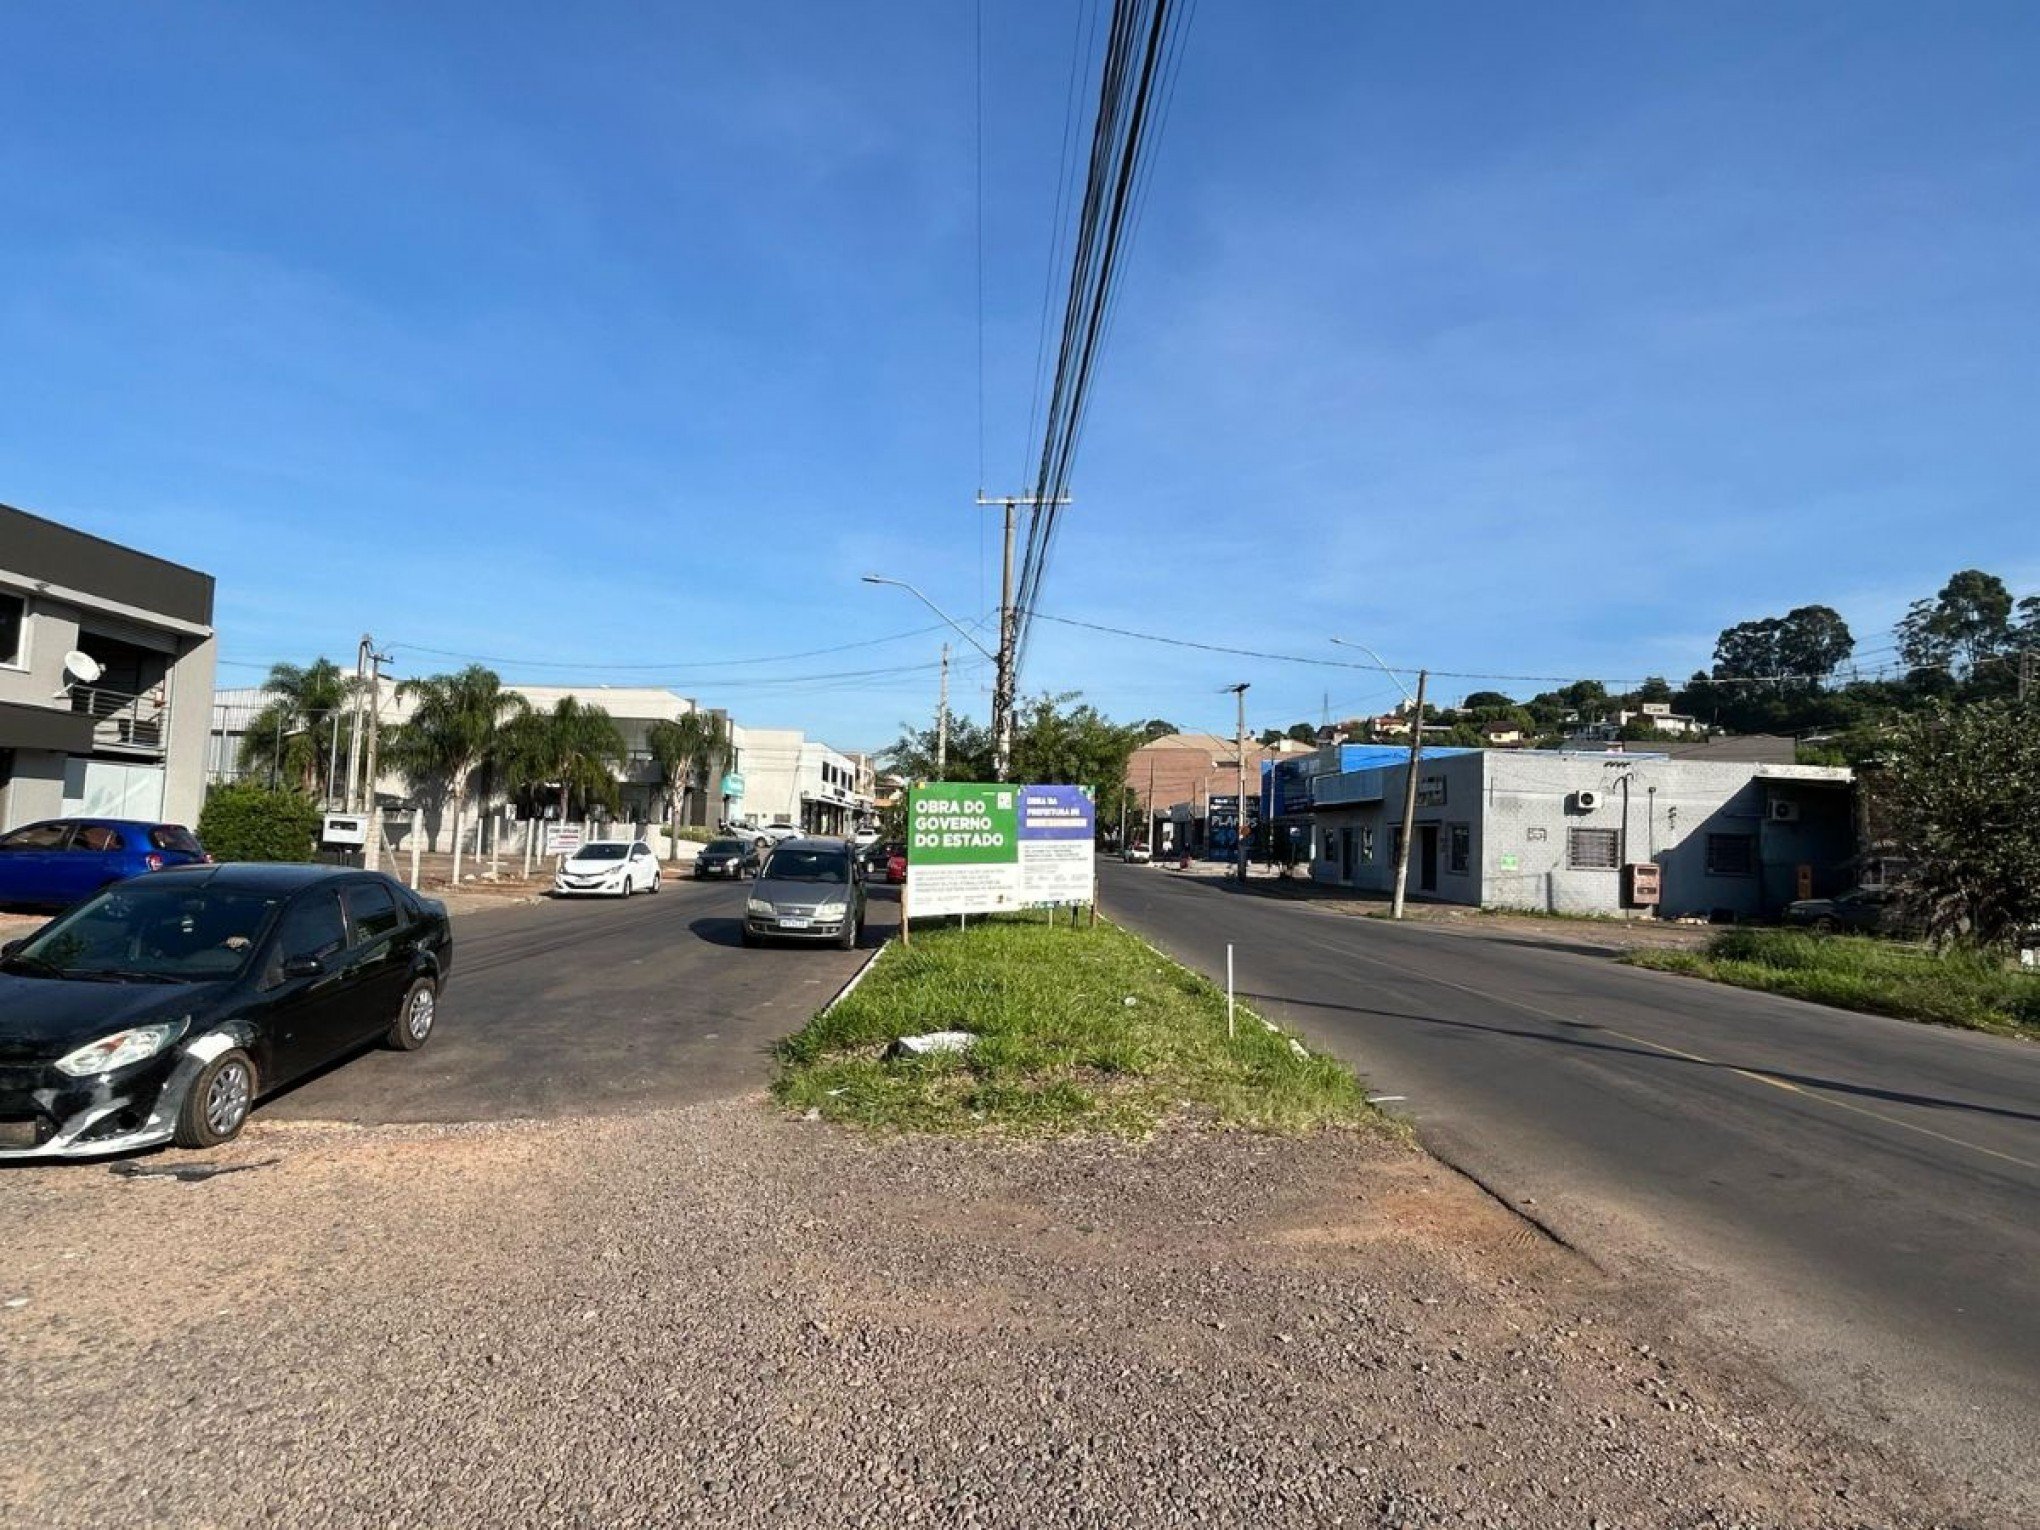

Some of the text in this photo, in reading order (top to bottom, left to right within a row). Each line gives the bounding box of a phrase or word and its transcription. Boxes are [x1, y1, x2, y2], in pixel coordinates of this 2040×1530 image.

[915, 800, 986, 814] OBRA DO
[915, 816, 992, 830] GOVERNO
[915, 832, 1004, 847] DO ESTADO
